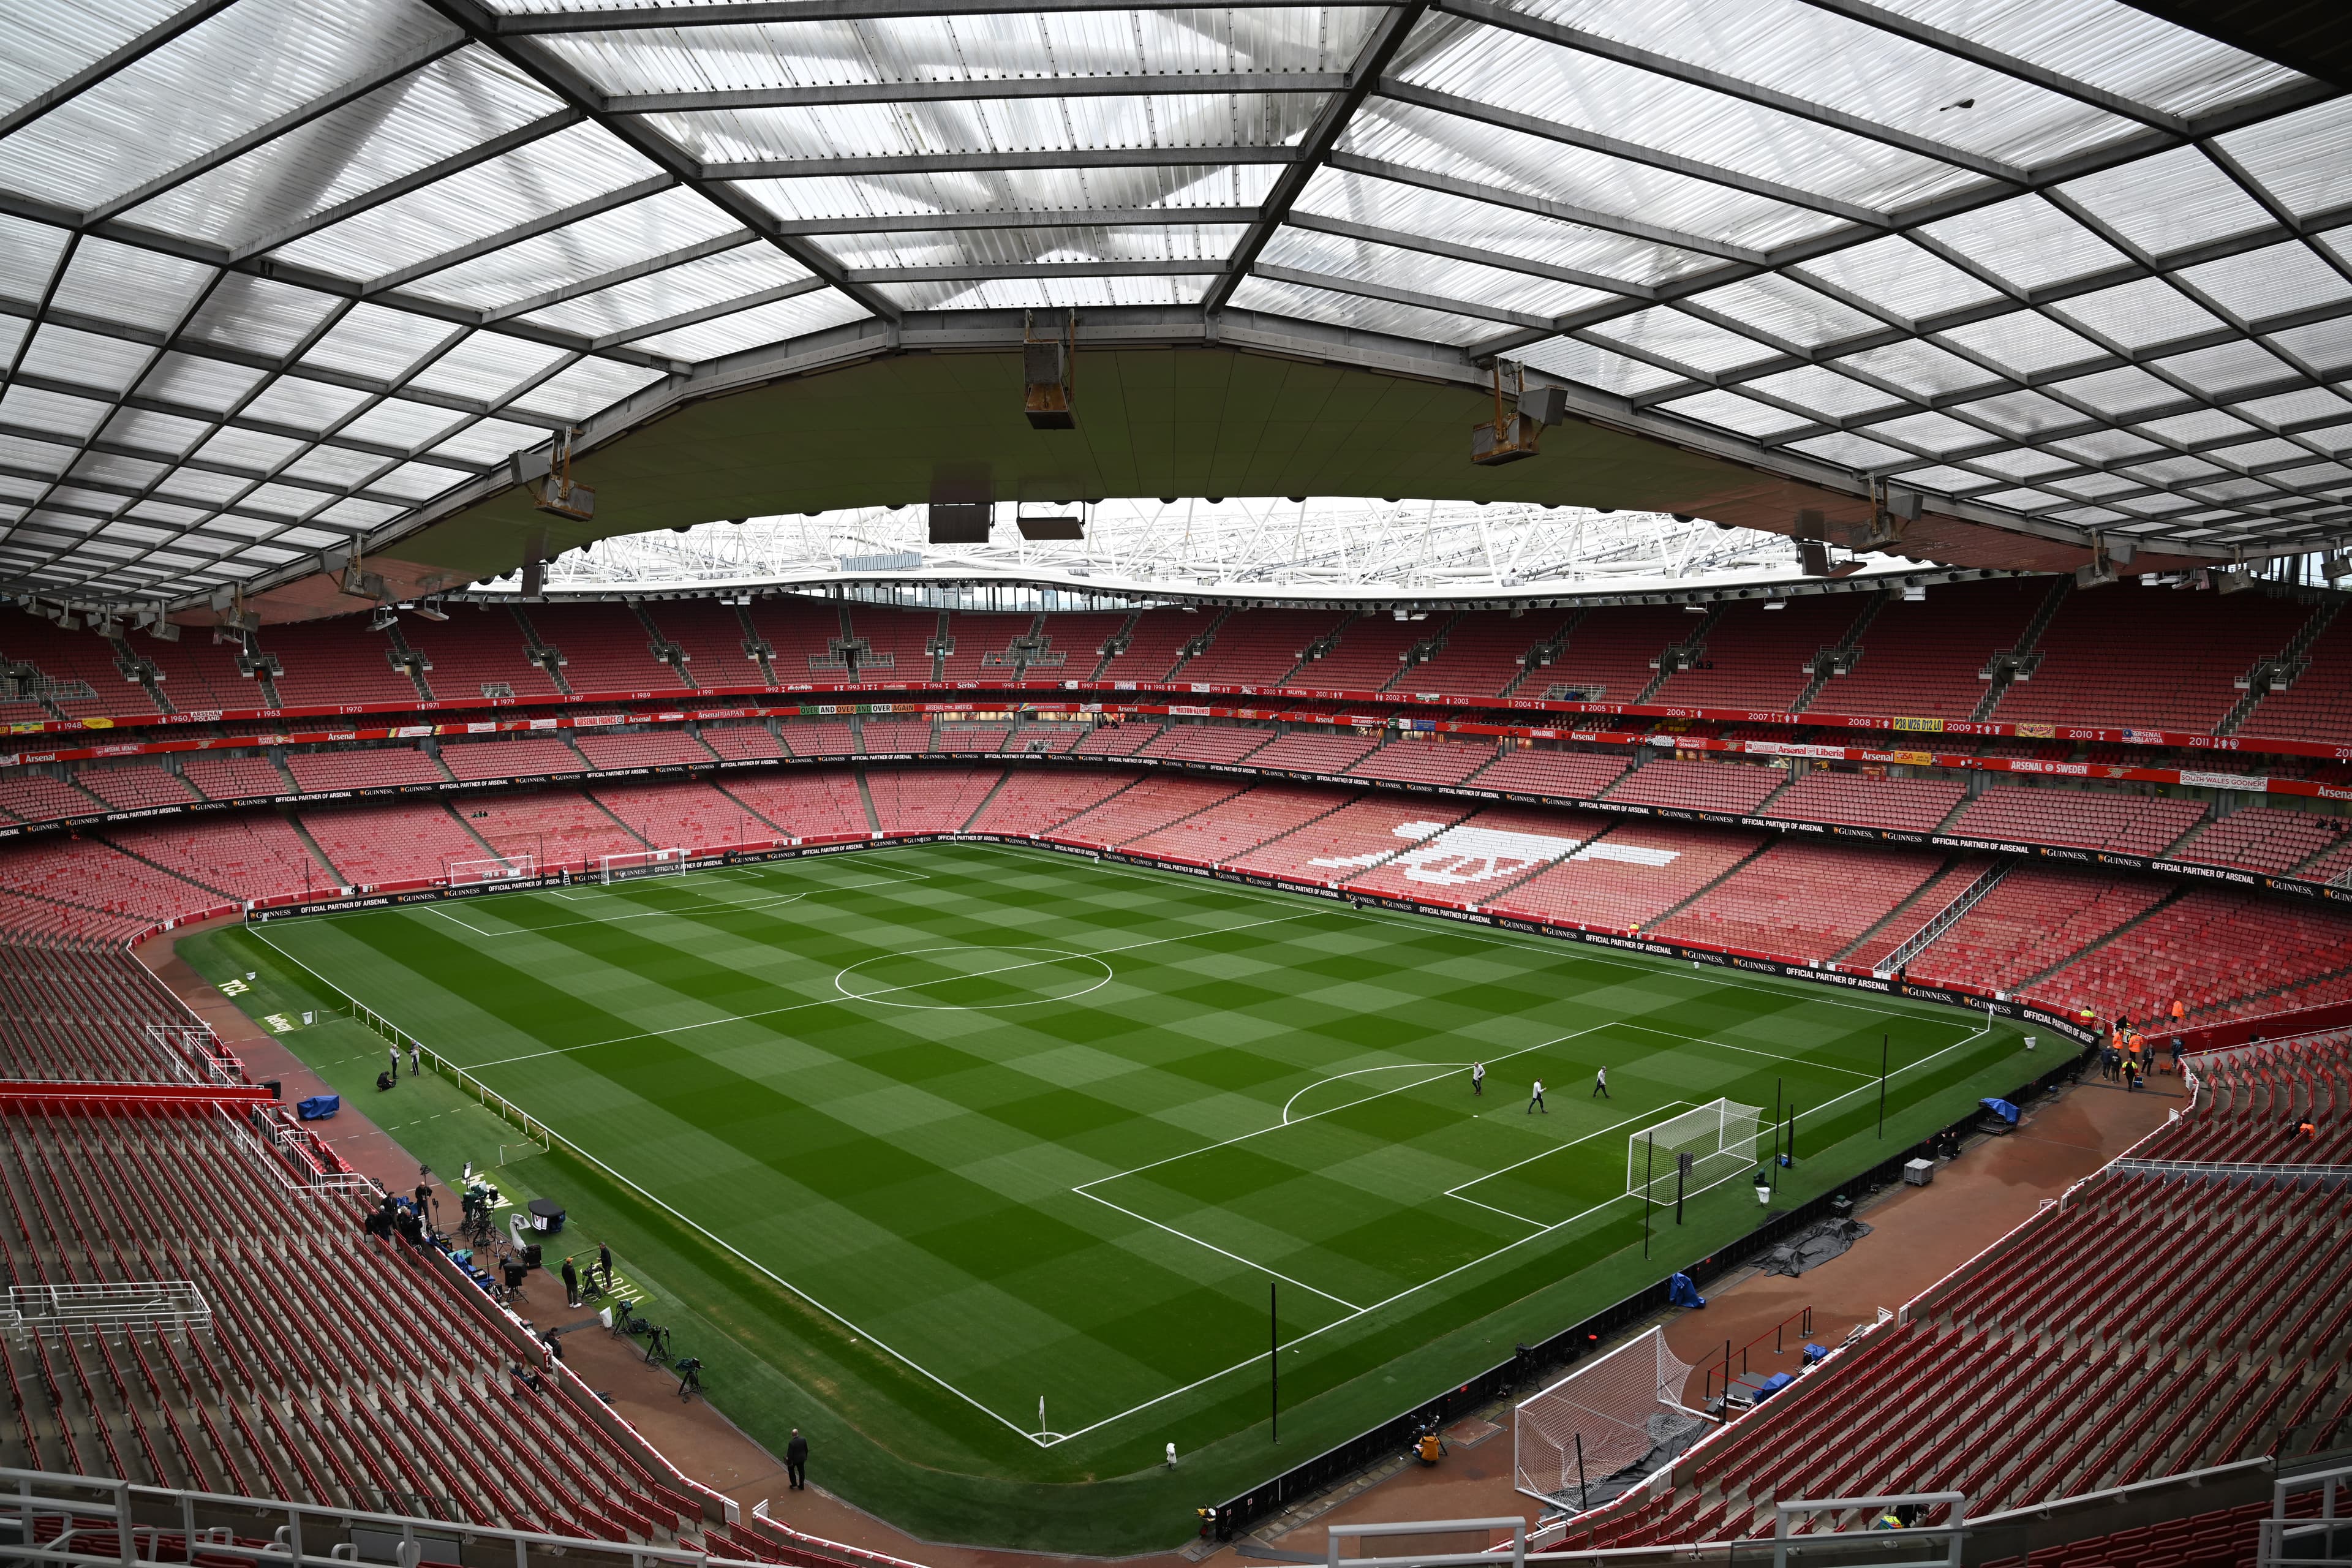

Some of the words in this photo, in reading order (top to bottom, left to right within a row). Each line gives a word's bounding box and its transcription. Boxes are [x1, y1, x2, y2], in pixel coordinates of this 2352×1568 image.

[577, 717, 598, 725] ARSENAL
[598, 715, 617, 725] FRANCE
[1894, 718, 1906, 729] P38
[1908, 719, 1920, 729] W26
[1922, 720, 1933, 730] D12
[1947, 723, 1971, 732] 2009
[1571, 732, 1596, 741] Arsenal
[2069, 730, 2093, 739] 2010
[2188, 737, 2209, 746] 2011
[1778, 746, 1806, 755] Arsenal
[1816, 747, 1844, 757] Liberia
[1861, 752, 1894, 762] Arsenal
[26, 753, 55, 763] Arsenal
[2011, 761, 2042, 771] ARSENAL
[2056, 764, 2087, 774] SWEDEN
[2231, 778, 2266, 787] GOONERS
[1510, 794, 1536, 803] GUINNESS
[1662, 810, 1691, 820] GUINNESS
[1704, 814, 1733, 823] GUINNESS
[1766, 820, 1790, 829] PARTNER
[1839, 827, 1872, 838] GUINNESS
[1888, 832, 1921, 842] GUINNESS
[1932, 837, 1959, 846] OFFICIAL
[1961, 840, 1989, 849] PARTNER
[1999, 844, 2029, 853] ARSENAL
[2047, 849, 2086, 860] GUINNESS
[2104, 855, 2141, 867] GUINNESS
[2152, 862, 2182, 872] OFFICIAL
[2183, 866, 2214, 877] PARTNER
[2226, 872, 2254, 884] ARSENAL
[1250, 878, 1271, 886] GUINNESS
[2272, 880, 2311, 894] GUINNESS
[1386, 900, 1412, 910] GUINNESS
[1420, 907, 1439, 915] OFFICIAL
[1441, 910, 1461, 919] PARTNER
[1469, 914, 1491, 924] ARSENAL
[1504, 920, 1534, 932] GUINNESS
[1547, 927, 1577, 938] GUINNESS
[1586, 935, 1610, 944] OFFICIAL
[1611, 938, 1636, 948] PARTNER
[1646, 944, 1672, 954] ARSENAL
[1688, 951, 1723, 964] GUINNESS
[1739, 960, 1775, 972] GUINNESS
[1787, 968, 1814, 978] OFFICIAL
[1816, 972, 1846, 984] PARTNER
[1858, 979, 1889, 991] ARSENAL
[218, 979, 250, 997] TCL
[1909, 987, 1951, 1003] GUINNESS
[264, 1014, 295, 1033] betway
[2024, 1009, 2051, 1024] OFFICIAL
[2052, 1018, 2073, 1034] PARTNER
[2073, 1026, 2079, 1036] OF
